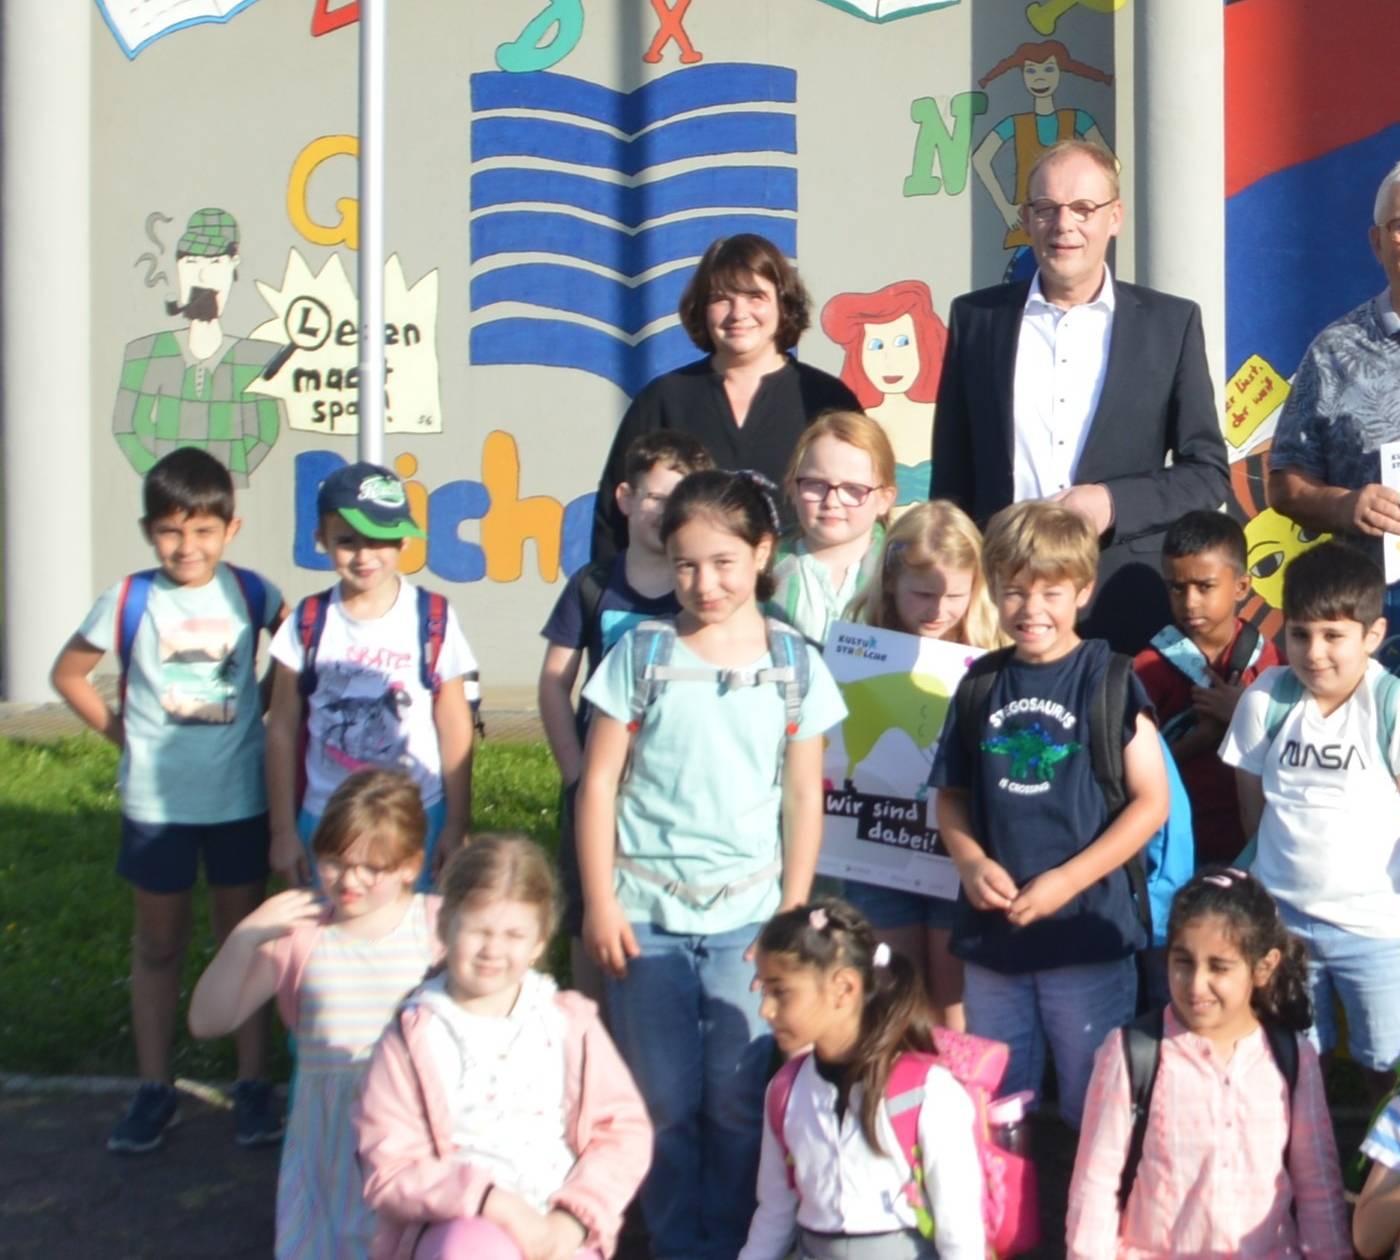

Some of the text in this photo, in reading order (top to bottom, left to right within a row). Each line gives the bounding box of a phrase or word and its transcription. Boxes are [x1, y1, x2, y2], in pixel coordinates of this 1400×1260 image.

[903, 91, 989, 198] N
[1280, 739, 1366, 770] NASA
[826, 794, 919, 821] Wir sind
[868, 821, 938, 852] dabei!
